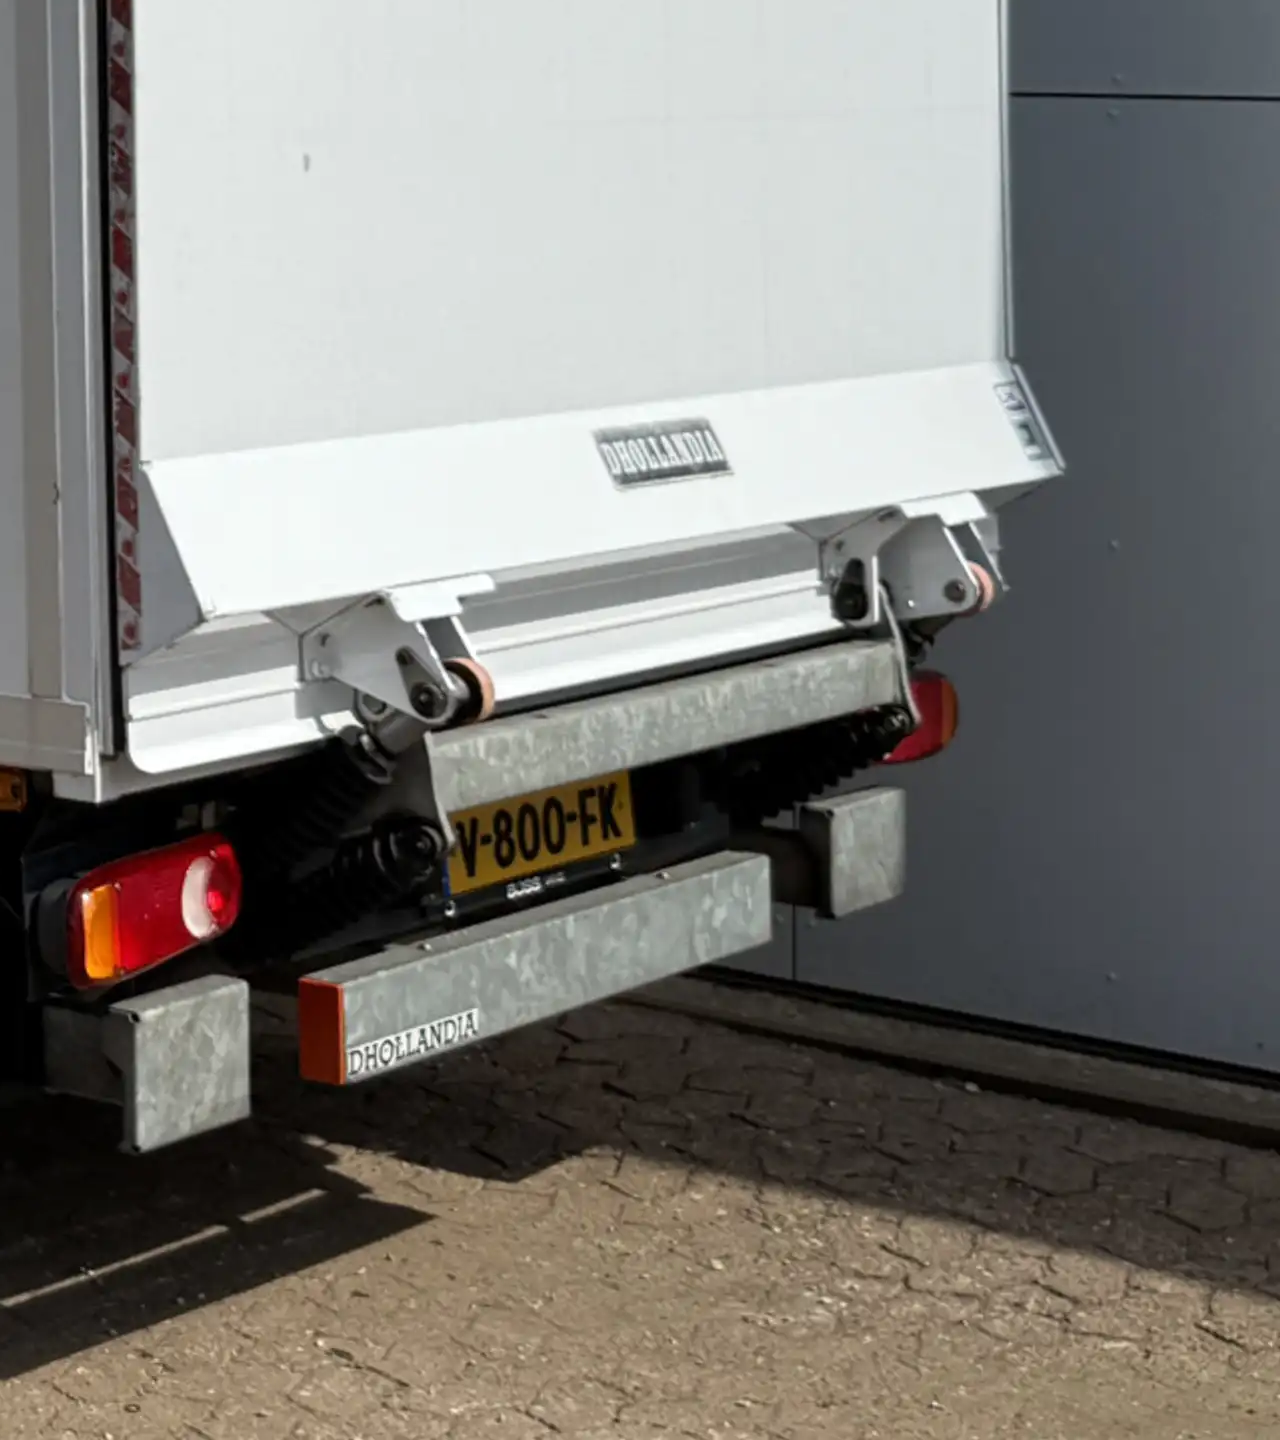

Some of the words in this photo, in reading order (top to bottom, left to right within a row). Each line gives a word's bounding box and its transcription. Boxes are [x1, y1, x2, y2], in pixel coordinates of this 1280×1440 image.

[599, 429, 724, 475] DHOLLANDIA
[456, 782, 623, 878] V-800-FK
[348, 1011, 479, 1076] DHOLLANDIA
